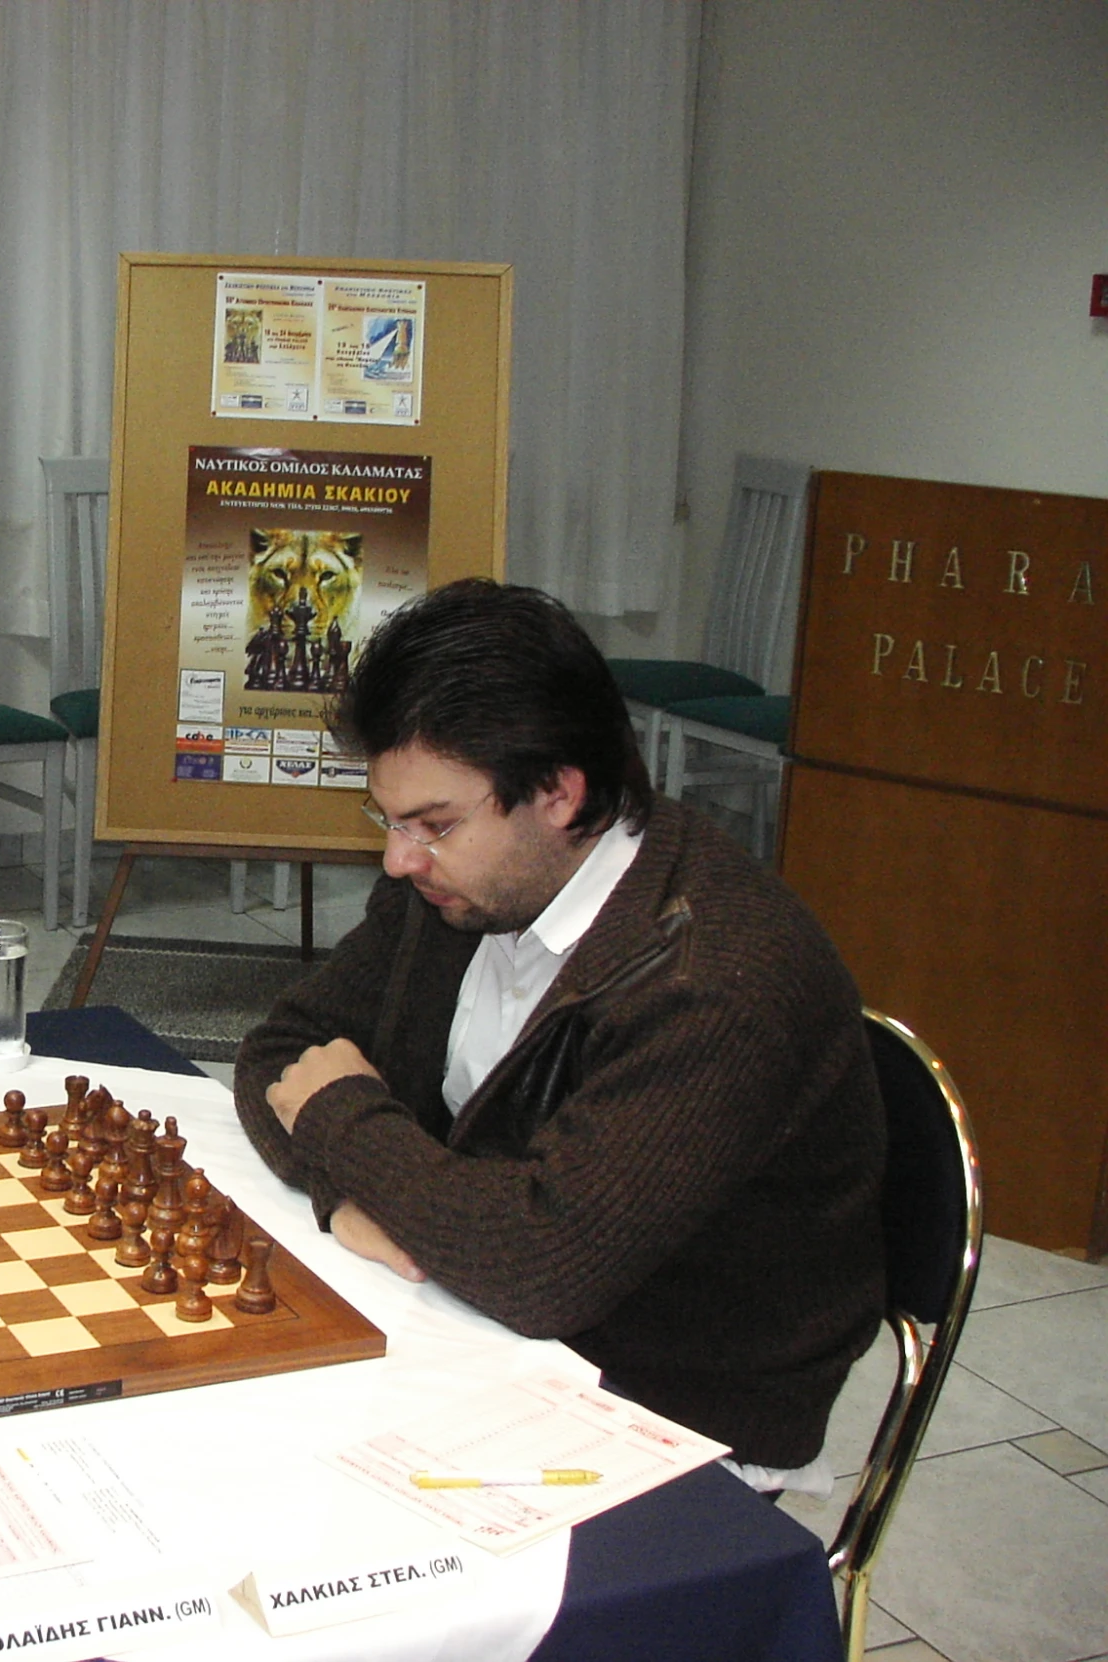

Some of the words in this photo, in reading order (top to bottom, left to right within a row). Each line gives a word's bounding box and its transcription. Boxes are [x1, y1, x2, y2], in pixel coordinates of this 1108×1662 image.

[195, 458, 268, 473] ΝΑΥΤΙΚΟΣ
[270, 460, 329, 475] ΟΜΙΛΟΣ
[331, 463, 423, 480] ΚΑΛΑΜΑΤΑΣ
[206, 479, 316, 500] ΑΚΑΔΗΜΙΑ
[324, 484, 411, 504] ΣΚΑΚΙΟΥ
[842, 532, 1095, 605] PHARA
[871, 632, 1088, 704] PALACE
[269, 1576, 363, 1609] ΧΑΛΚΙΑΣ
[367, 1565, 426, 1588] ΣΤΕΛ.
[429, 1555, 463, 1579] (GM)
[97, 1606, 171, 1632] ΓΙΑΝΝ.
[175, 1597, 212, 1622] (GM)
